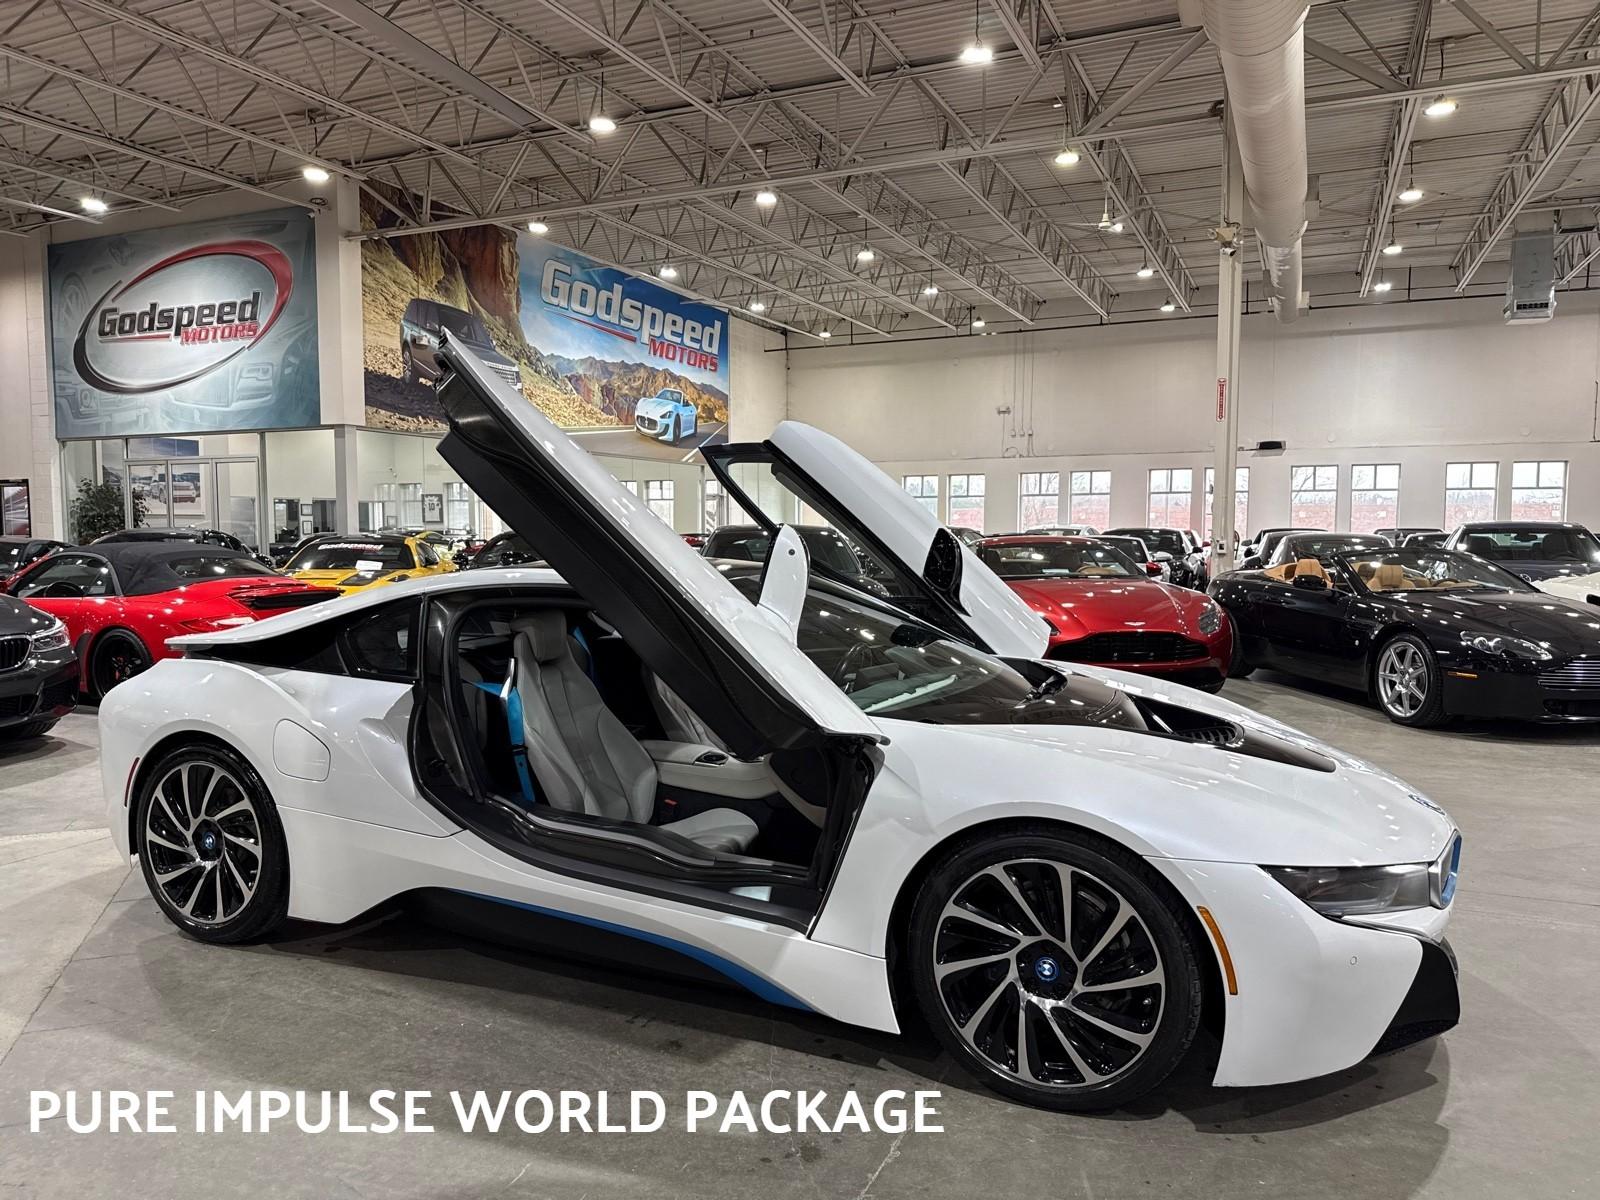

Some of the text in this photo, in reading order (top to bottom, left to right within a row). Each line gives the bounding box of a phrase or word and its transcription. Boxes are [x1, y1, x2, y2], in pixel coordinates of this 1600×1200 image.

[98, 290, 261, 337] Godspeed
[540, 258, 722, 355] Godspeed
[180, 322, 260, 345] MOTORS
[648, 336, 719, 372] MOTORS
